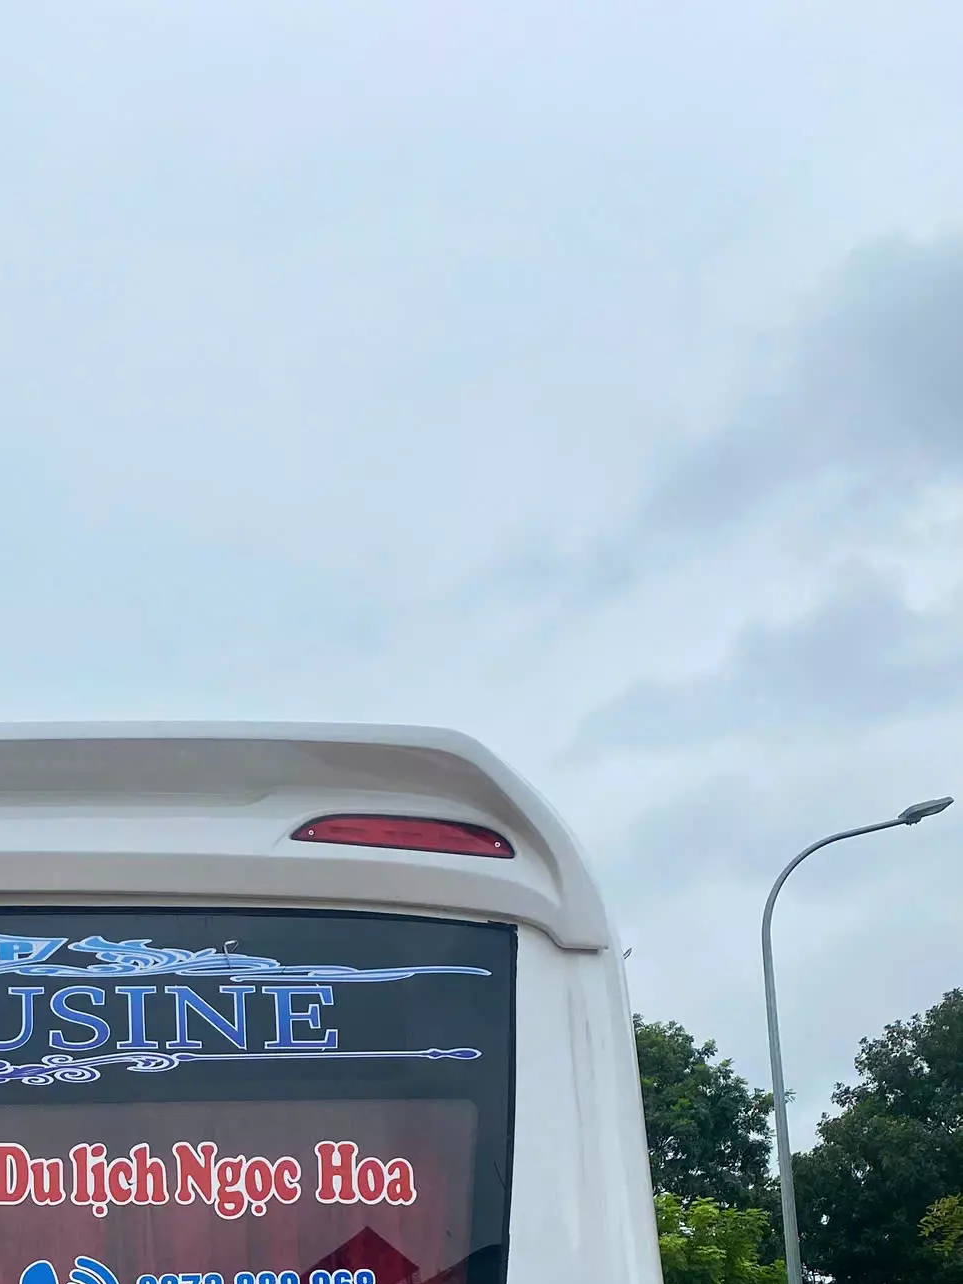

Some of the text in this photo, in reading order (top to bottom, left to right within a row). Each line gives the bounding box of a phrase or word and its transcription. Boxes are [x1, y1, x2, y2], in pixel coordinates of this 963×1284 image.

[69, 1143, 169, 1217] lịch
[172, 1141, 302, 1219] Ngọc
[314, 1140, 418, 1206] Hoa
